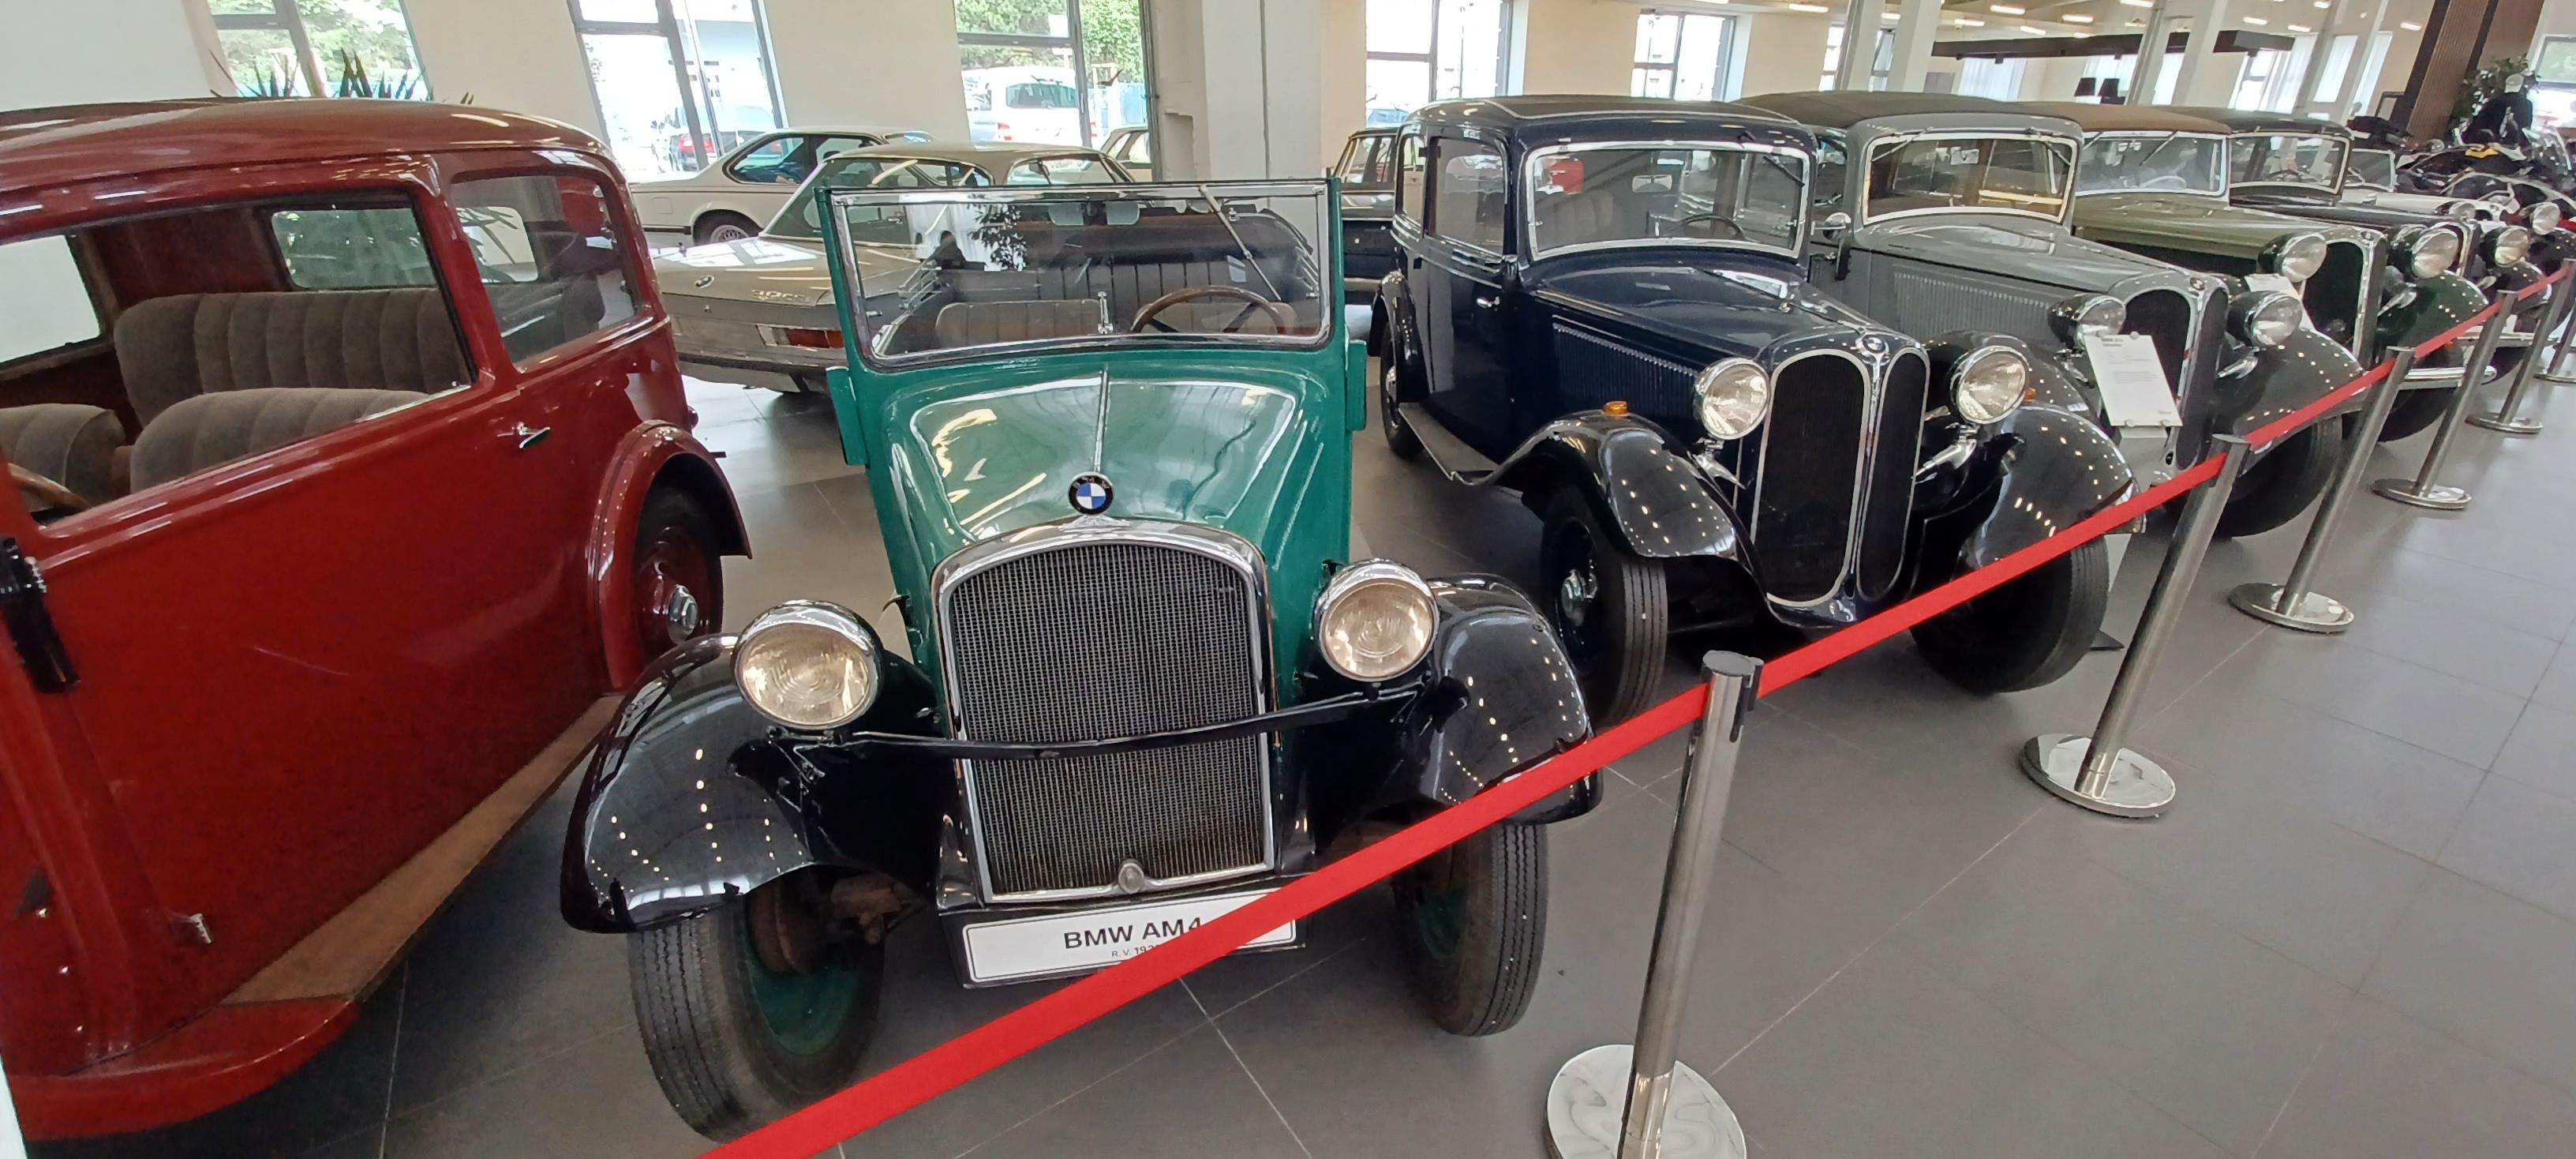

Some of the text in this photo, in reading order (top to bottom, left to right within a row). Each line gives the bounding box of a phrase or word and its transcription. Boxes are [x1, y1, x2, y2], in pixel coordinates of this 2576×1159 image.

[1064, 917, 1201, 949] BMW AM4
[1134, 944, 1159, 955] 19
